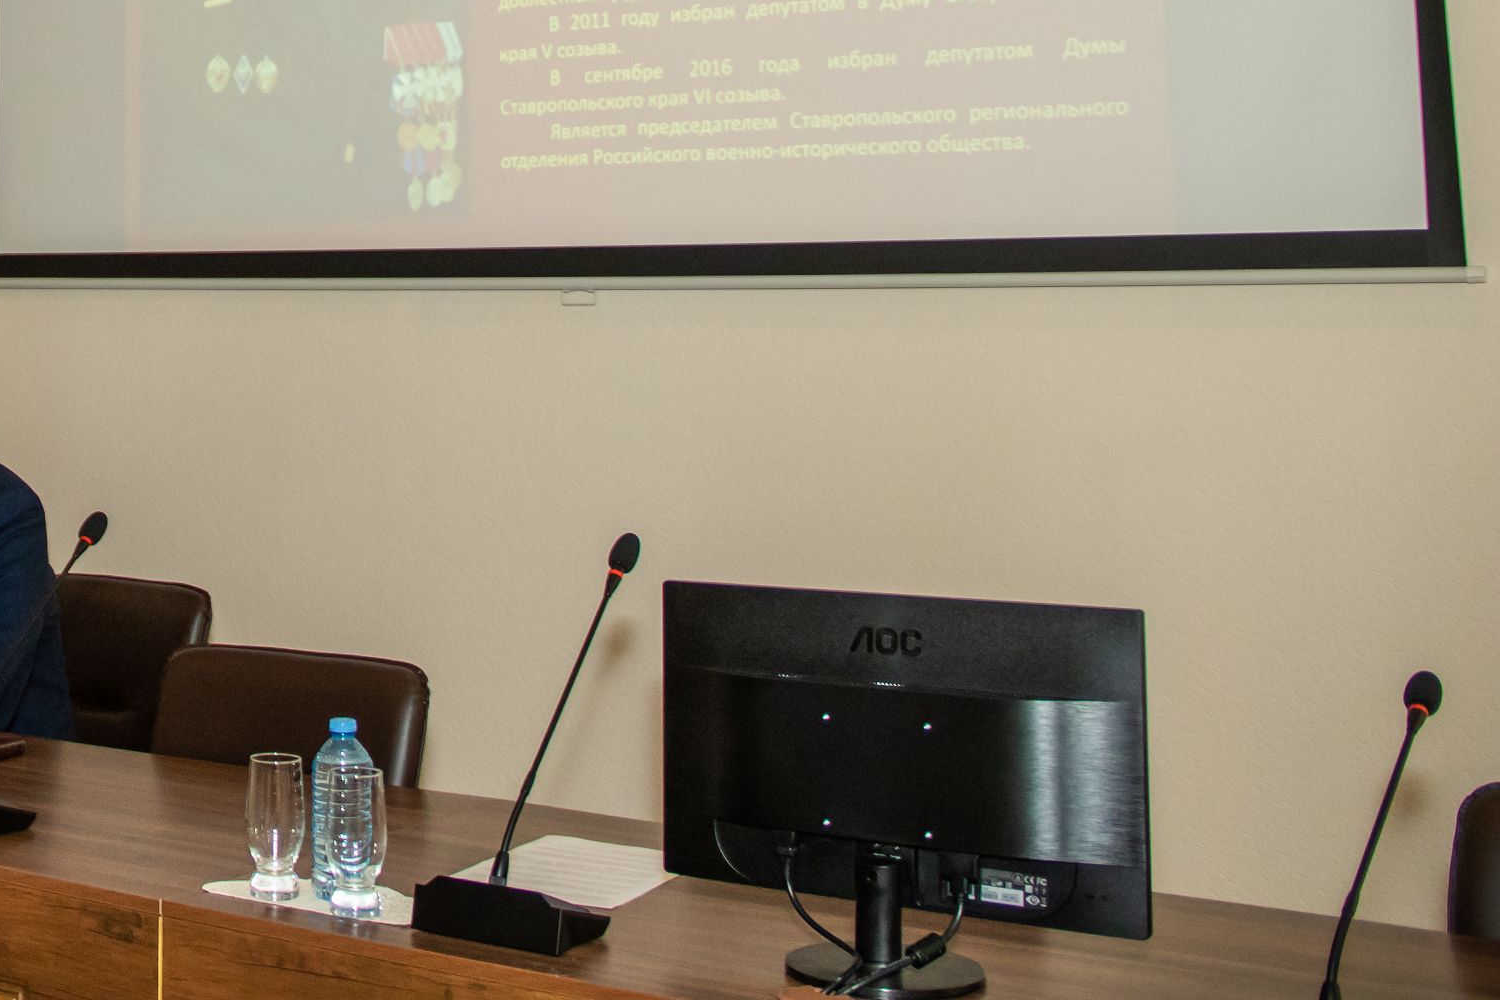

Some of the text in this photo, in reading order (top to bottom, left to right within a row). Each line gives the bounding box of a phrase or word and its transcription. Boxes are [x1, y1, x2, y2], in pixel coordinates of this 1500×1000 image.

[570, 11, 610, 30] 2011
[621, 11, 659, 28] году
[670, 4, 734, 24] избран
[499, 47, 536, 64] края
[541, 42, 552, 59] V
[584, 37, 1125, 83] сентябре 2016 года избран депутатом Думы
[500, 95, 643, 116] Ставропольского
[648, 93, 688, 110] края
[693, 88, 710, 105] VI
[550, 101, 1128, 139] Является председателем Ставропольского регионального
[500, 153, 588, 170] отделения
[593, 146, 701, 165] Российского
[705, 140, 921, 161] военно-исторического
